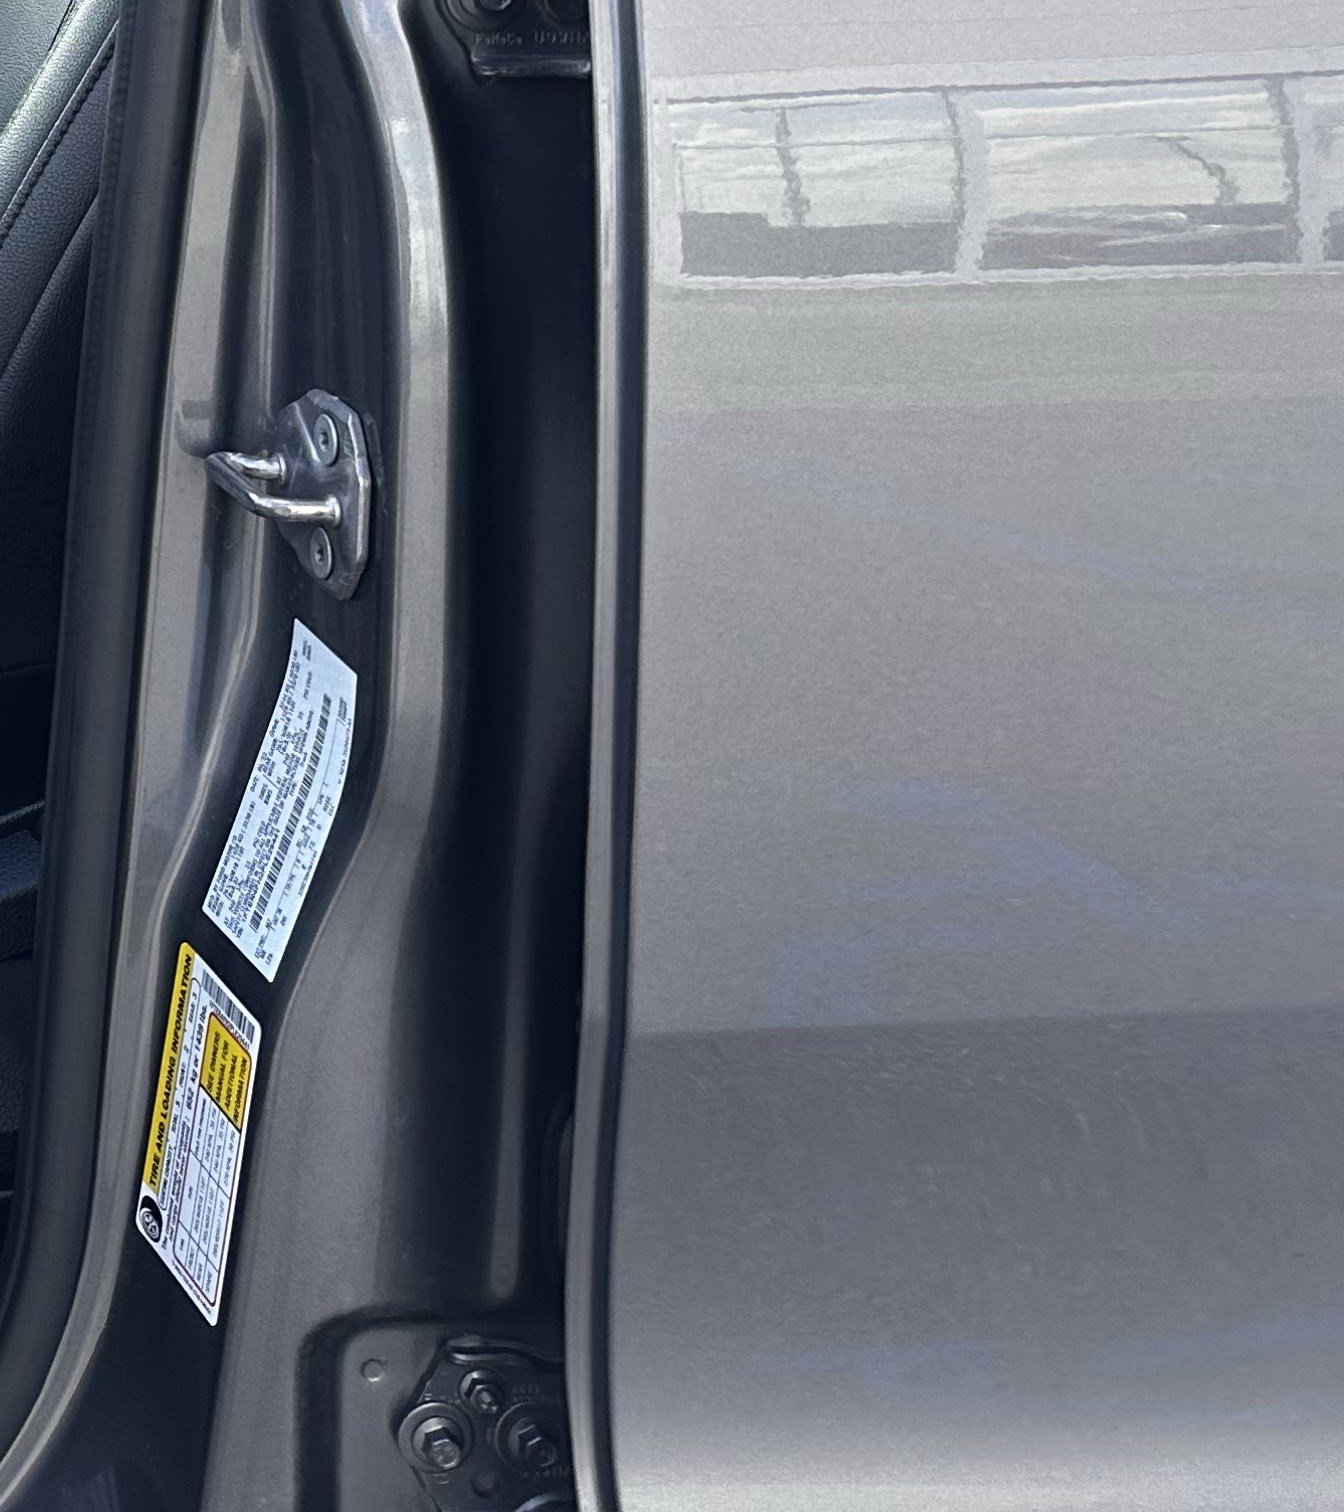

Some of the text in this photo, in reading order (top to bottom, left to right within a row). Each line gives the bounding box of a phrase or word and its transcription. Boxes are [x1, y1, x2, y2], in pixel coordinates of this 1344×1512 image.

[148, 953, 191, 1186] TIRE AND LOADING INFORMATION
[209, 1031, 220, 1072] OWNERS
[215, 1039, 229, 1102] MANUAL FOR
[224, 1054, 237, 1110] ADDITIONAL
[232, 1056, 247, 1122] INFORMATION
